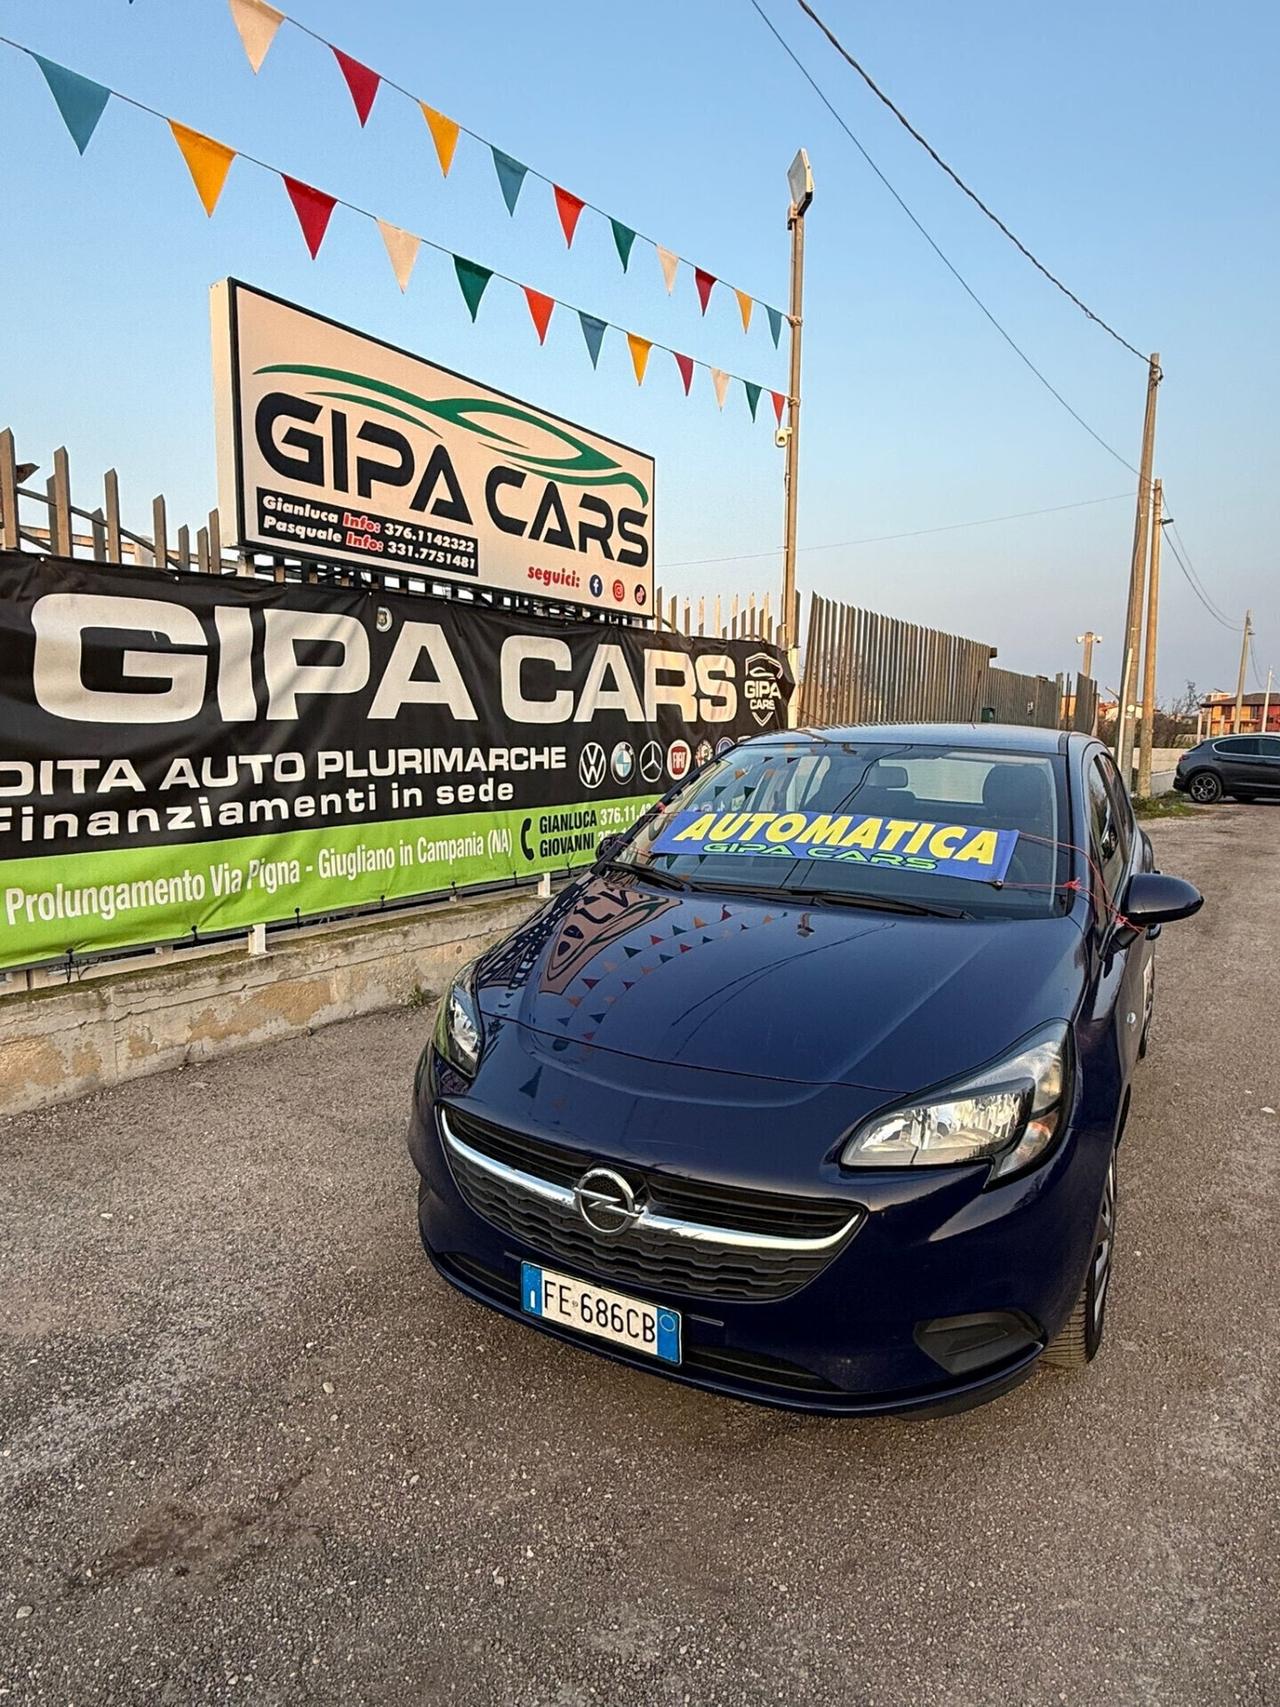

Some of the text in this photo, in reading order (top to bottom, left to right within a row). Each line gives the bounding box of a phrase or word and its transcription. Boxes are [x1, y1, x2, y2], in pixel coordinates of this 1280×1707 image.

[255, 392, 649, 567] GIPA CARS
[263, 495, 474, 553] Gianluca Info: 376.1142322
[263, 515, 475, 569] Pasquale Info: 331.7751481
[527, 565, 580, 588] seguici:
[31, 593, 737, 723] GIPA CARS
[744, 681, 781, 699] GIPA
[749, 699, 775, 710] CARS
[159, 752, 306, 791] AUTO
[318, 747, 566, 779] PLURIMARCHE
[392, 782, 422, 808] in
[436, 780, 514, 805] sede
[539, 810, 597, 834] GIANLUCA
[672, 813, 998, 864] AUTOMATICA
[539, 832, 594, 857] GIOVANNI
[702, 843, 938, 870] GIPA CARS
[5, 868, 206, 925] Prolungamento
[210, 864, 242, 896] Via
[248, 858, 301, 894] Pigna
[318, 845, 395, 880] Giugliano
[400, 840, 413, 866] in
[417, 832, 485, 865] Campania
[488, 827, 512, 857] (NA)
